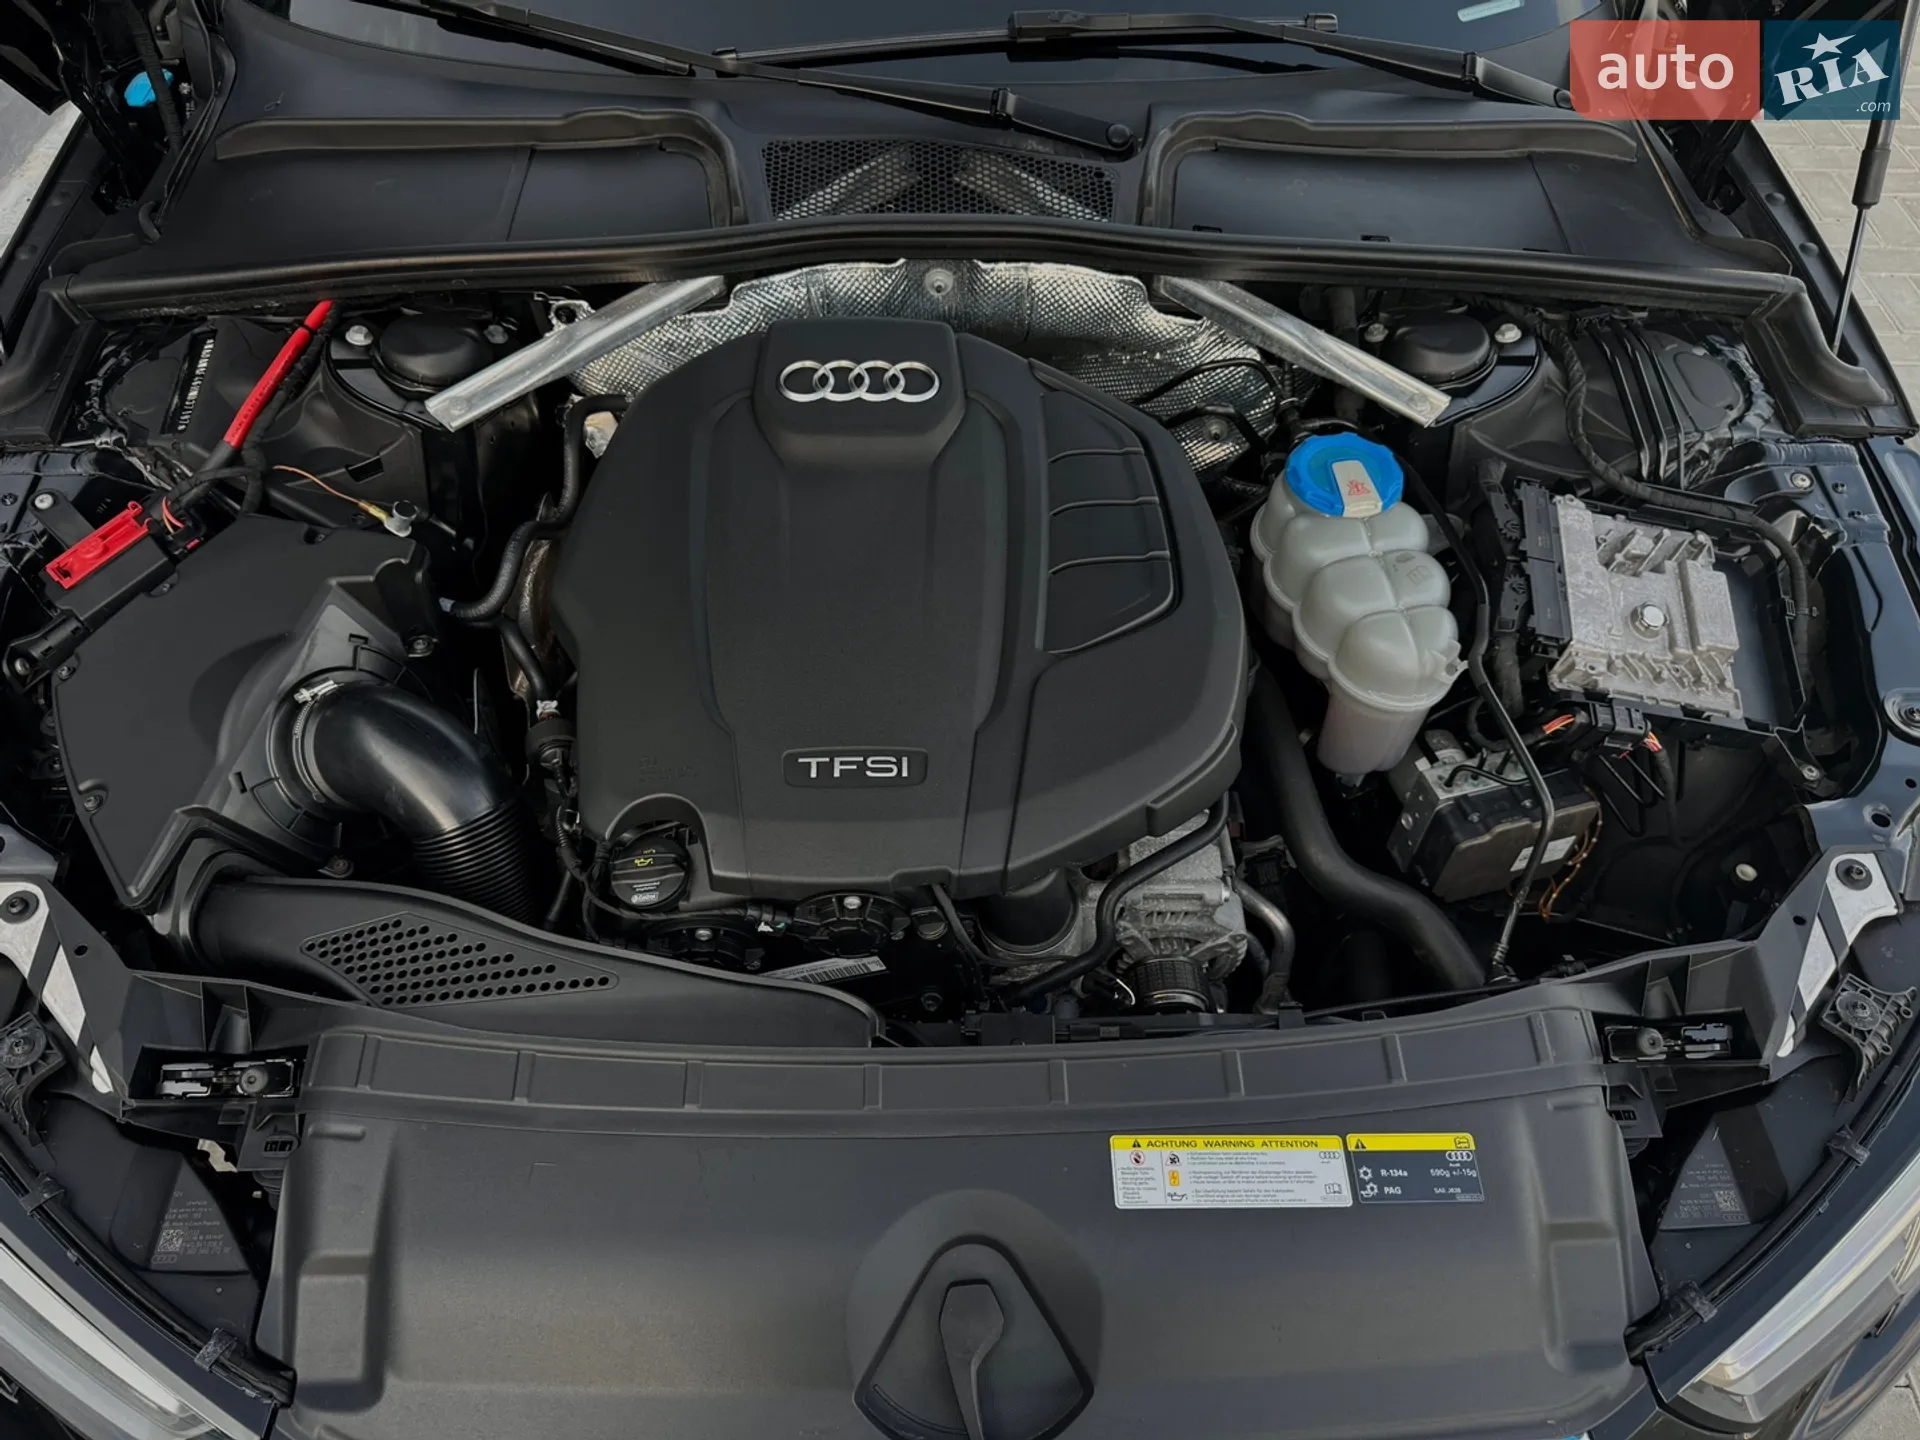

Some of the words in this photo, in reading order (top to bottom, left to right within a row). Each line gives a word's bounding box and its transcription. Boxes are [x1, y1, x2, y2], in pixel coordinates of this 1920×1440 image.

[797, 756, 908, 778] TFSI
[1146, 1140, 1198, 1148] ACHTUNG
[1203, 1140, 1255, 1148] WARNING
[1261, 1139, 1318, 1148] ATTENTION
[1380, 1169, 1408, 1177] R-134a
[1384, 1186, 1402, 1195] PAG
